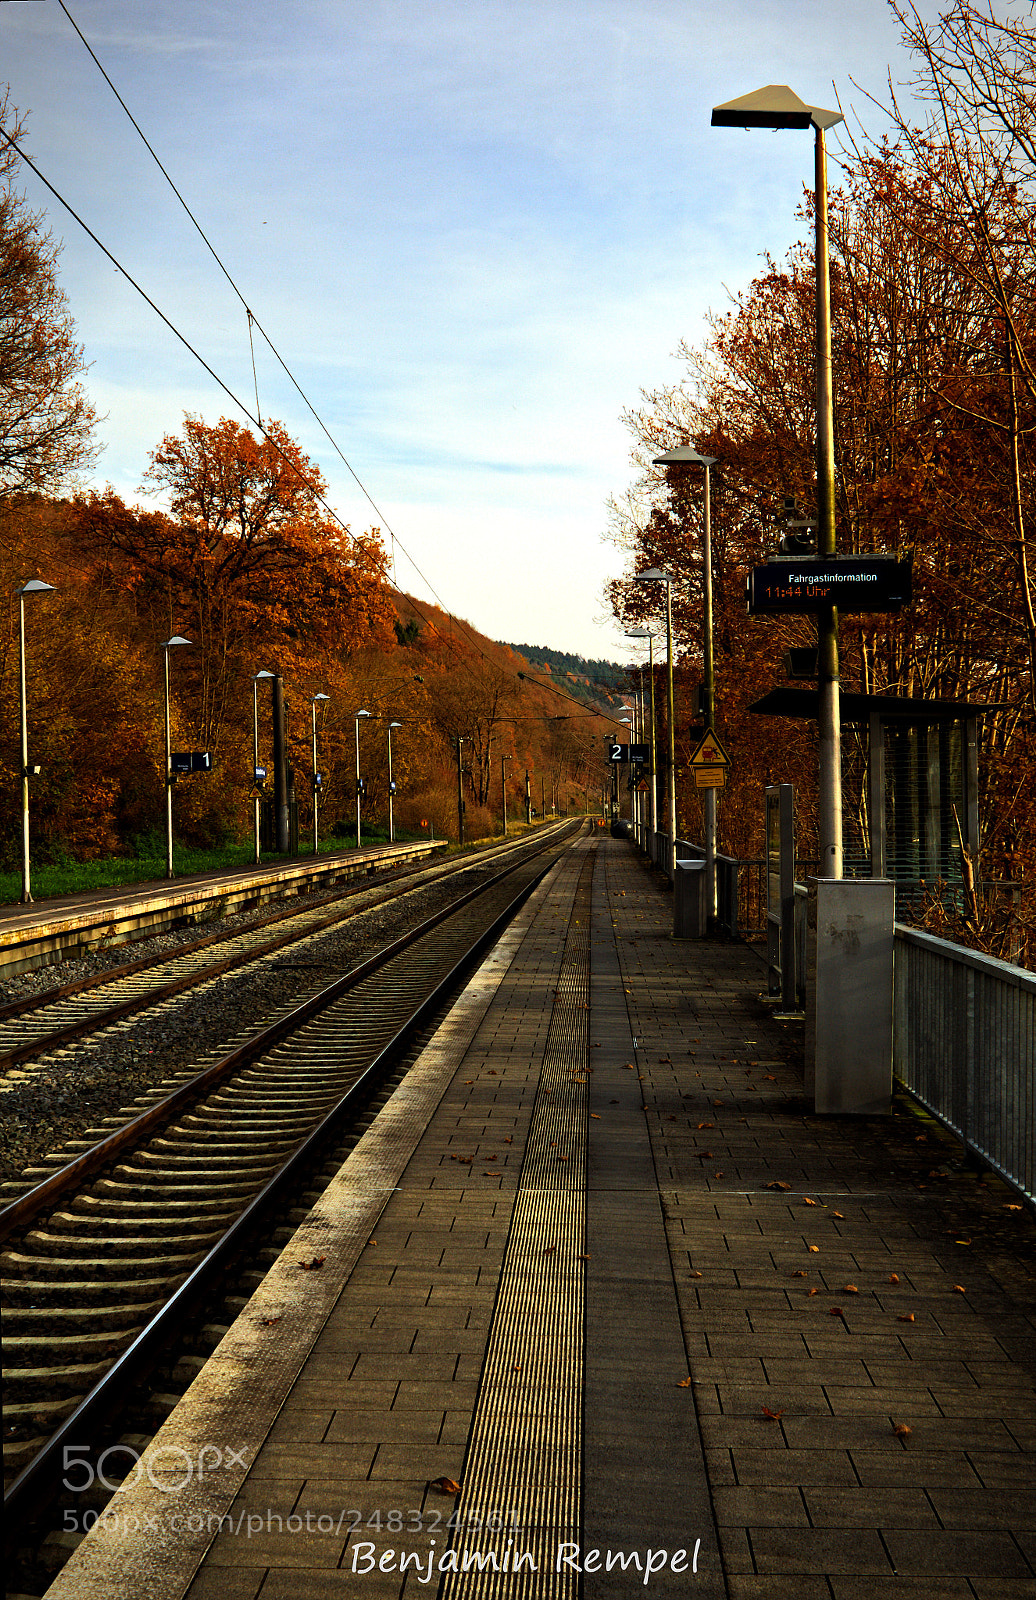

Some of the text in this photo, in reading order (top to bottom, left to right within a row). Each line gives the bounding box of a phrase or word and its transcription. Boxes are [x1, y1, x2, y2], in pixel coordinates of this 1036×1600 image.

[788, 573, 878, 584] Fahrgastinformation
[765, 585, 831, 598] 11:44 Uhr
[611, 745, 622, 759] 2
[202, 752, 209, 767] 1
